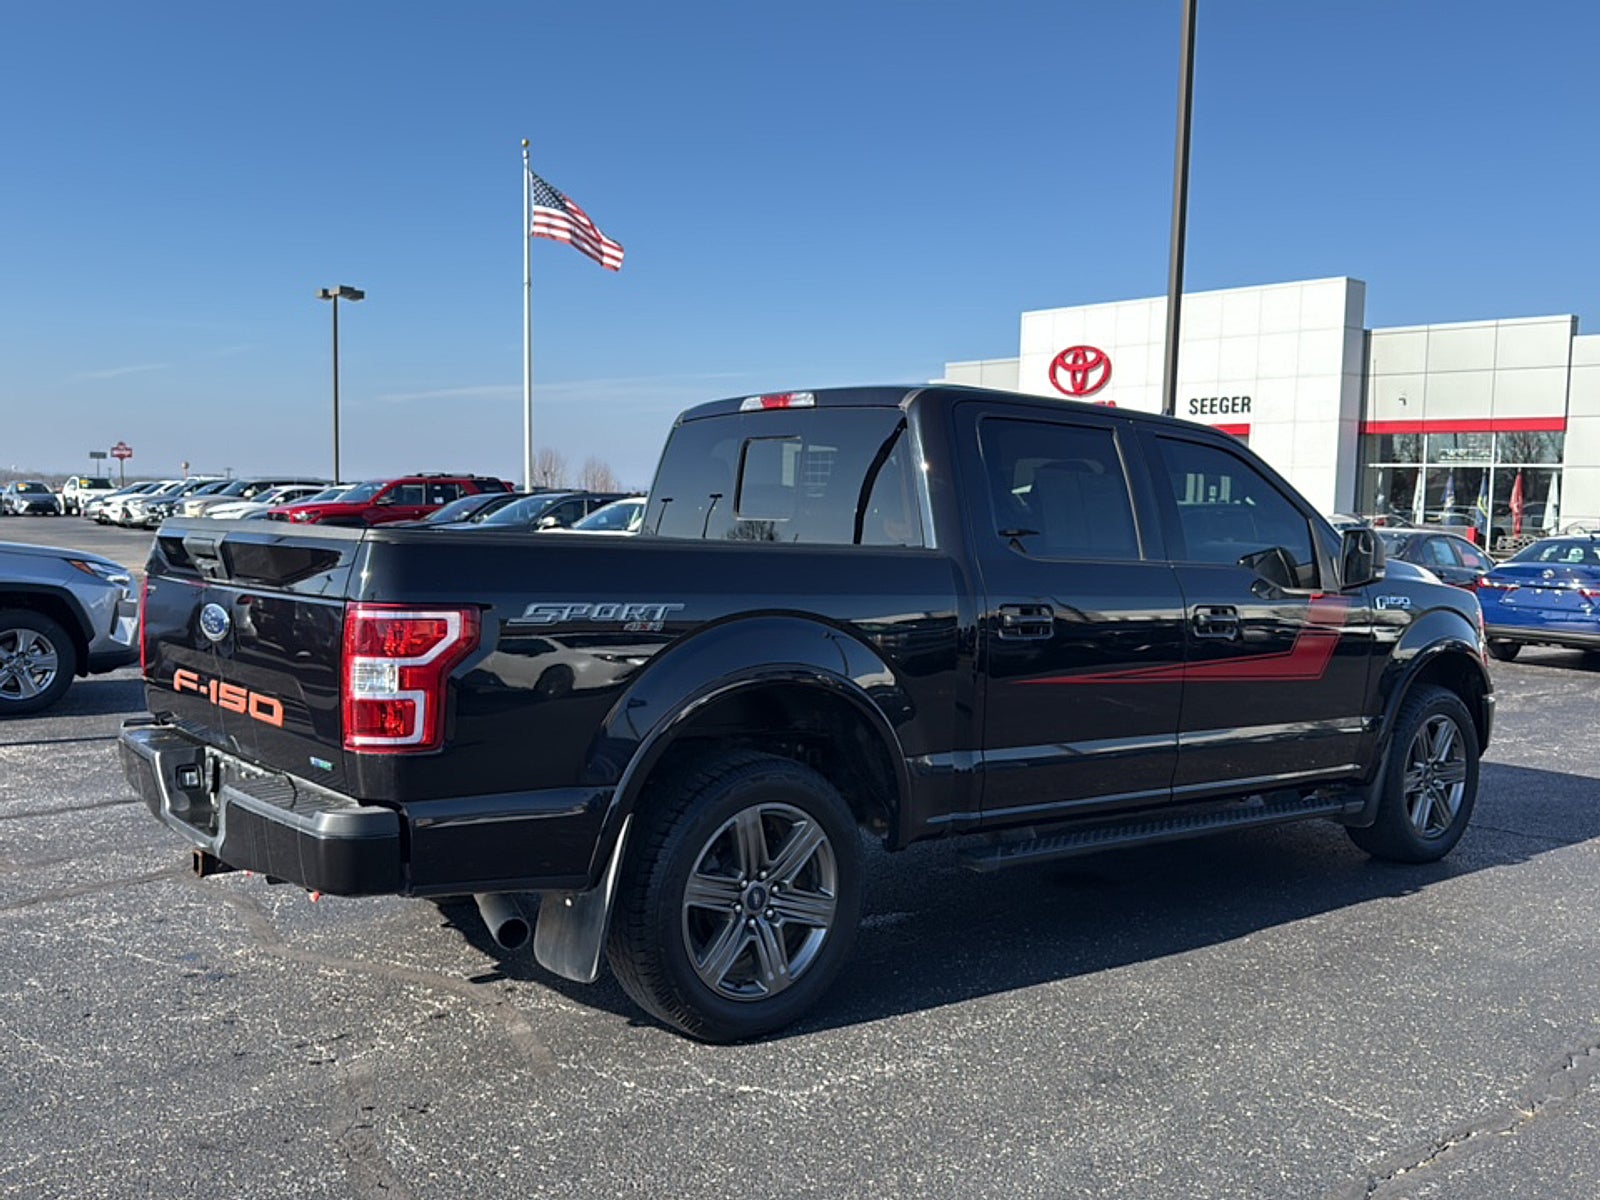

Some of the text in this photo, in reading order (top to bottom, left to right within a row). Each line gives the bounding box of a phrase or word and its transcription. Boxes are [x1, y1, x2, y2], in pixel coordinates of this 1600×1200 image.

[1189, 396, 1251, 415] SEEGER
[506, 602, 685, 627] SPORT
[173, 667, 285, 729] F-150
